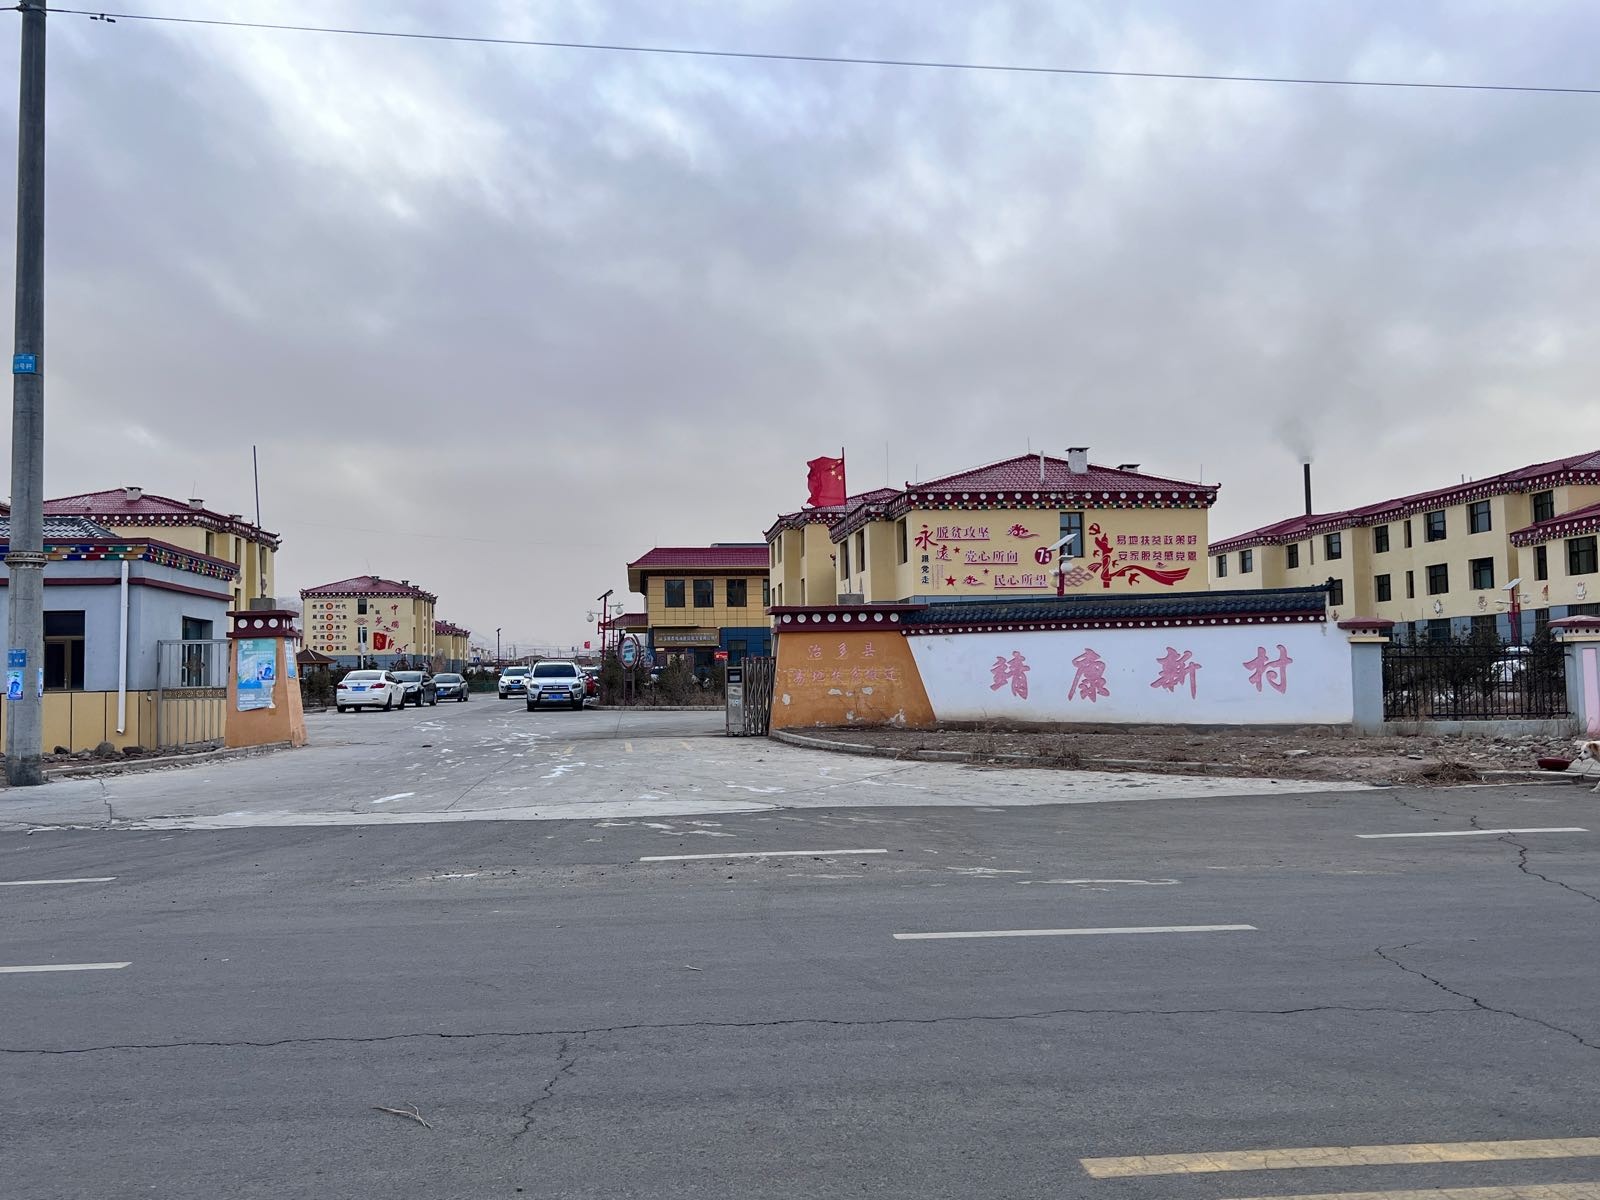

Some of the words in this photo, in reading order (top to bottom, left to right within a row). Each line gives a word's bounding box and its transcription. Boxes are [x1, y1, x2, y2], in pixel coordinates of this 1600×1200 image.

[936, 526, 989, 539] 脱贫攻坚
[1116, 535, 1197, 545] 易地扶贫政策好
[965, 550, 1018, 563] 党心所向
[1118, 551, 1197, 561] 安家脱贫感党恩
[994, 574, 1047, 587] 民心所望
[808, 641, 876, 658] 治多县
[989, 644, 1294, 703] 靖康新村
